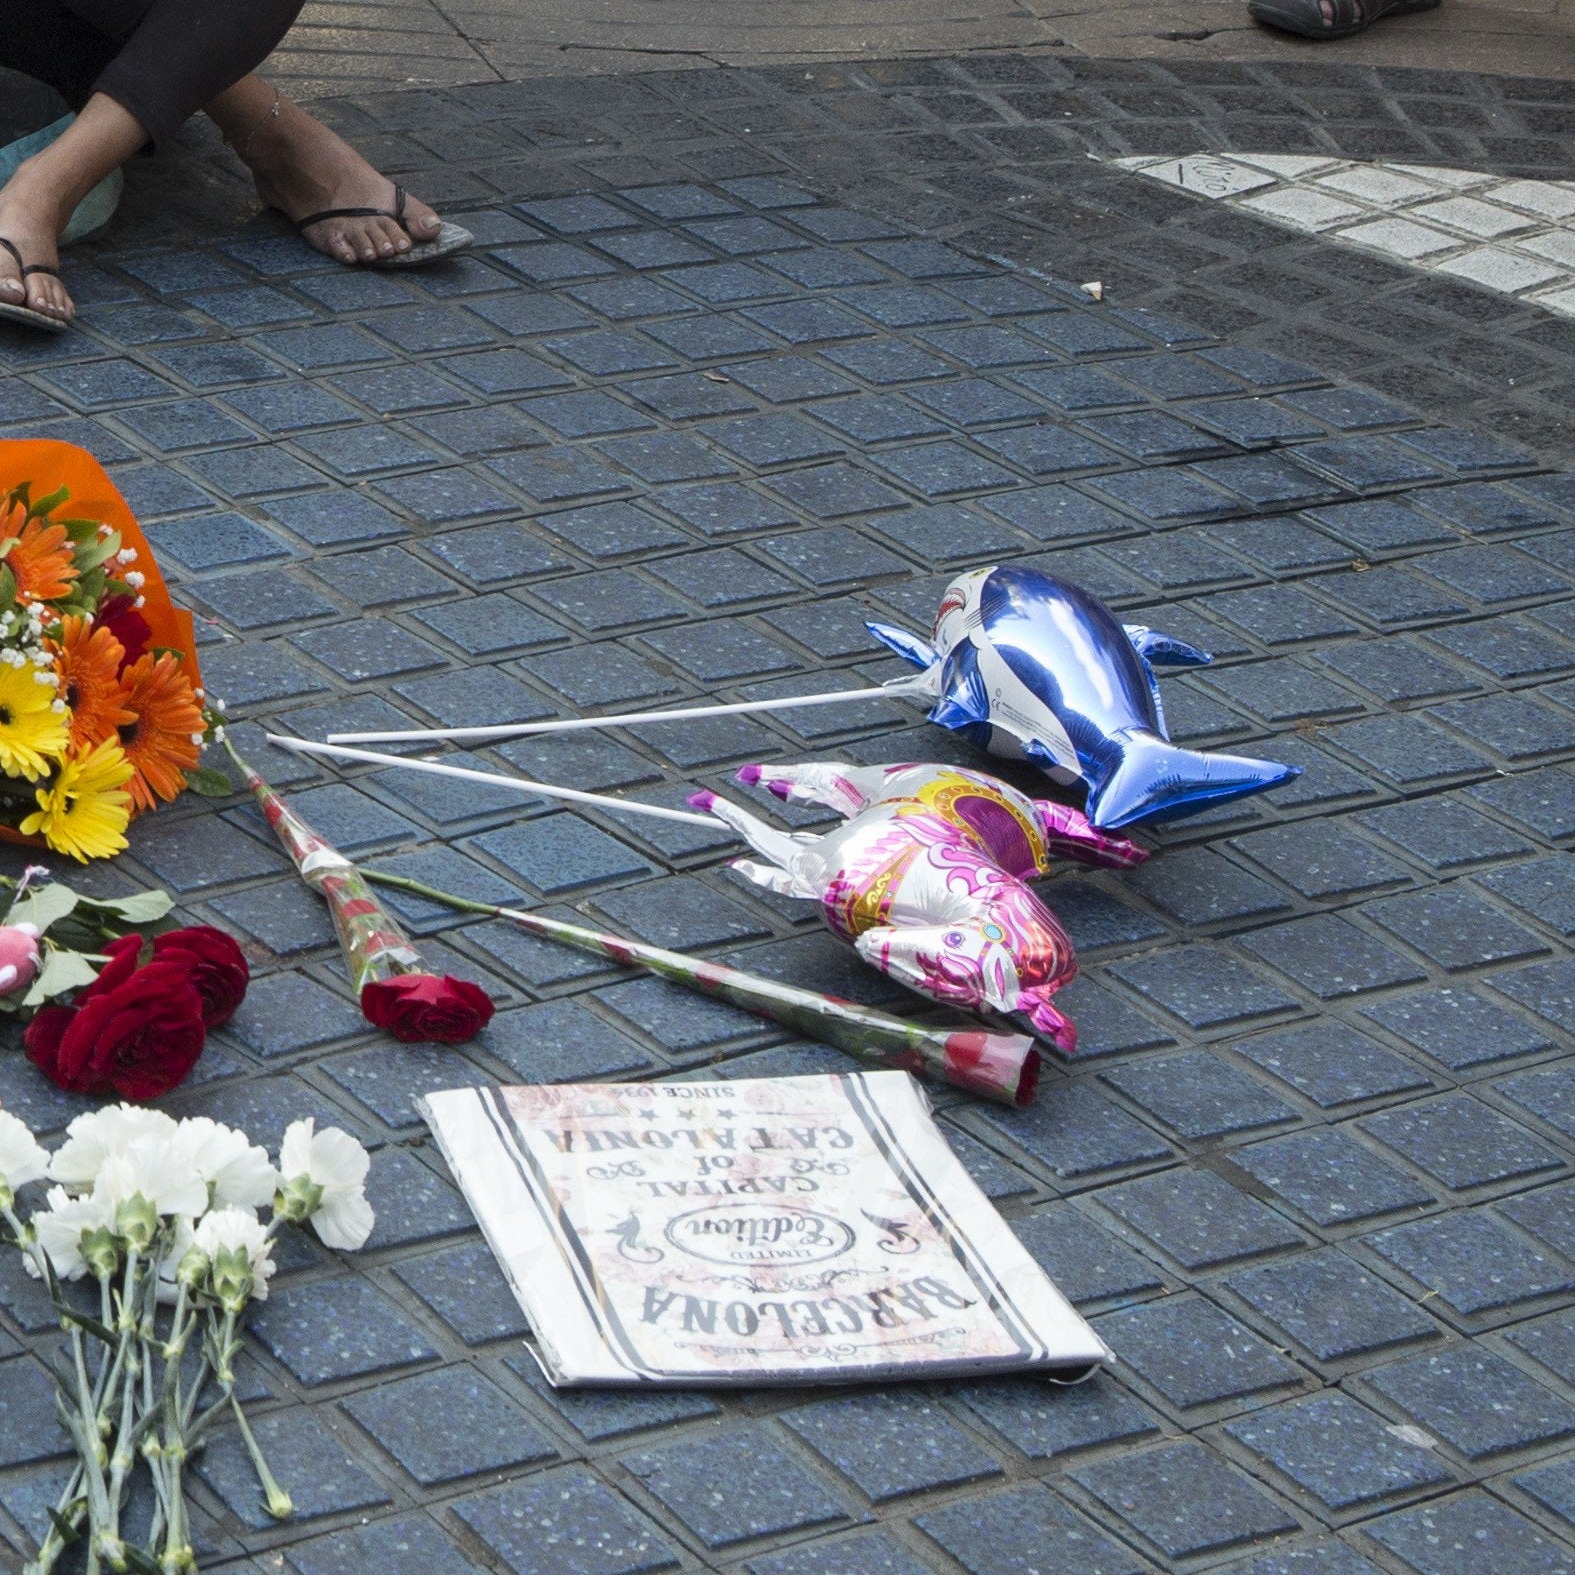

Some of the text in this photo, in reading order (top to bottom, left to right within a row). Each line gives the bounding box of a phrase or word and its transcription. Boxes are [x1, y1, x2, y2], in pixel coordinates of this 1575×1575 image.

[662, 1086, 737, 1099] SINCE
[541, 1127, 855, 1154] CATALONIA
[636, 1176, 820, 1198] CAPITAL
[685, 1212, 834, 1247] Edition
[730, 1247, 814, 1261] LIMITED
[641, 1275, 977, 1338] BARCELONA
